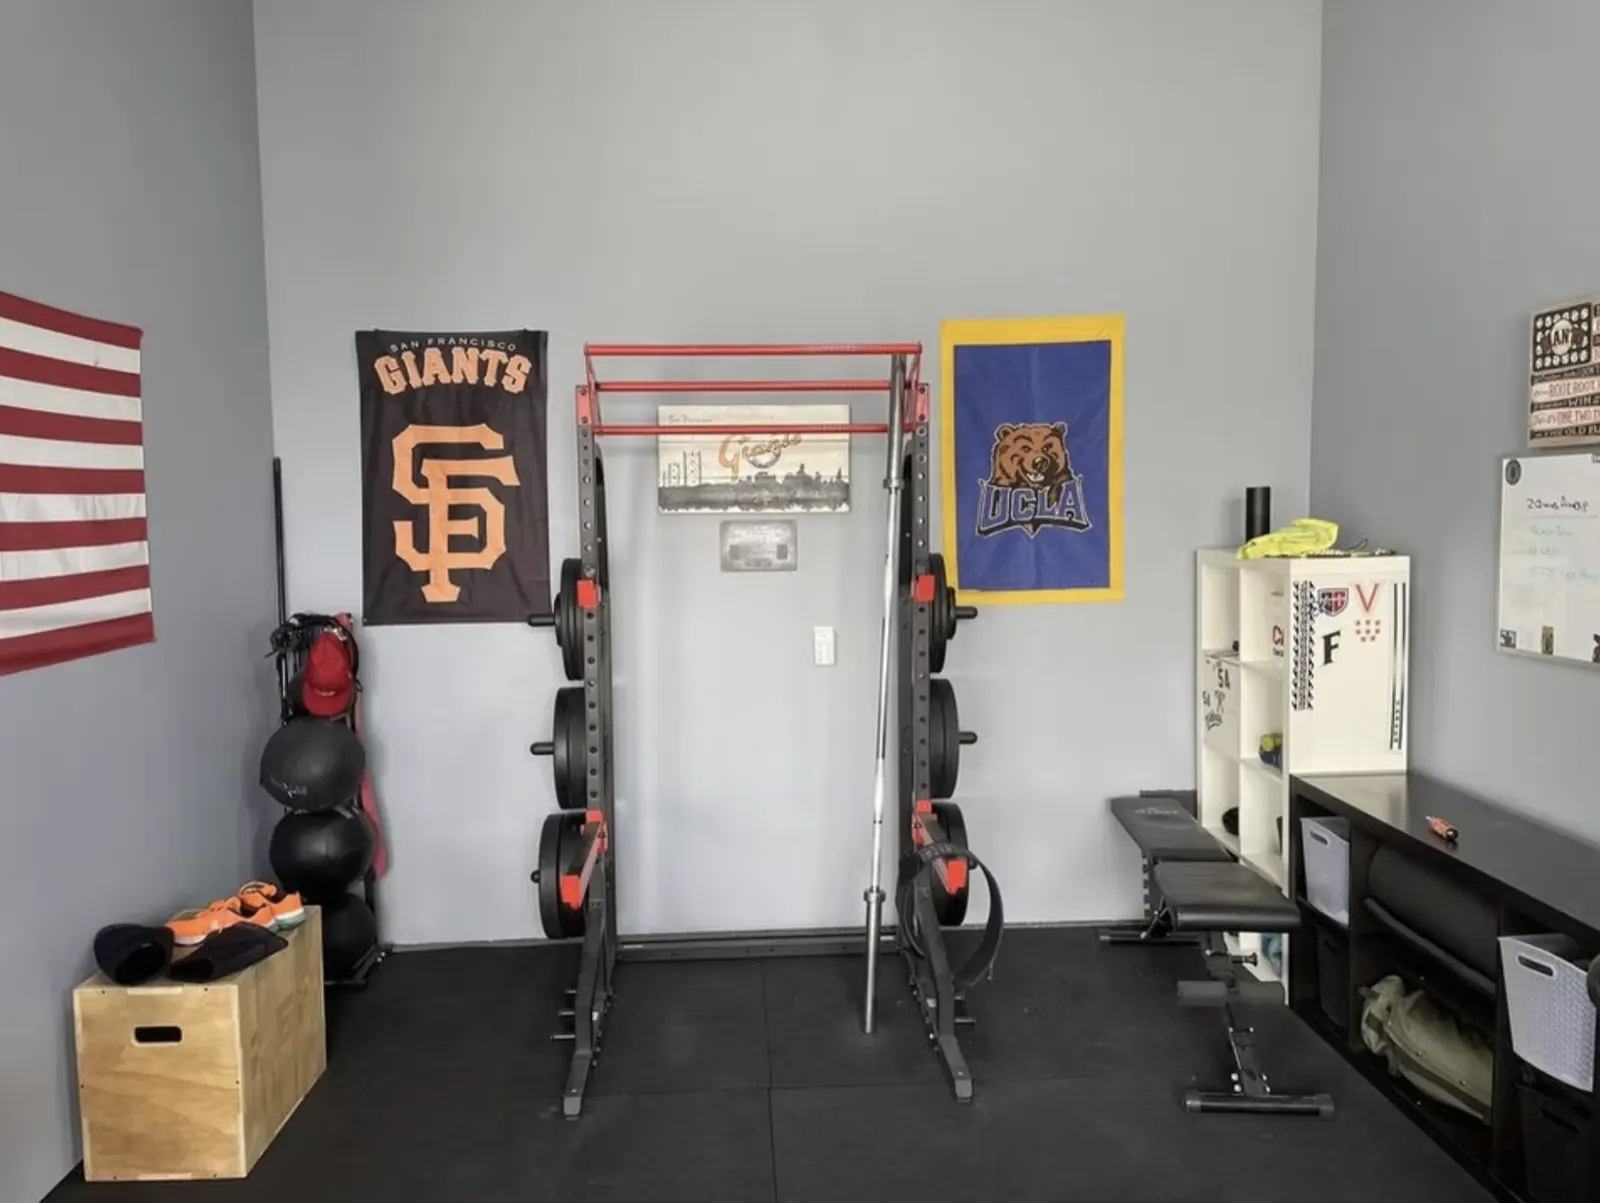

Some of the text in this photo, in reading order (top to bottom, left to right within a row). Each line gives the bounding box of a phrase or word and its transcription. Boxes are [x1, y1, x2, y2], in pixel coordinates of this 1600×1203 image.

[389, 337, 517, 352] SAN FRANCISCO
[374, 346, 532, 395] GIANTS
[392, 423, 520, 602] SF
[976, 474, 1092, 538] UCLA
[1356, 583, 1380, 613] V
[1322, 629, 1341, 666] F
